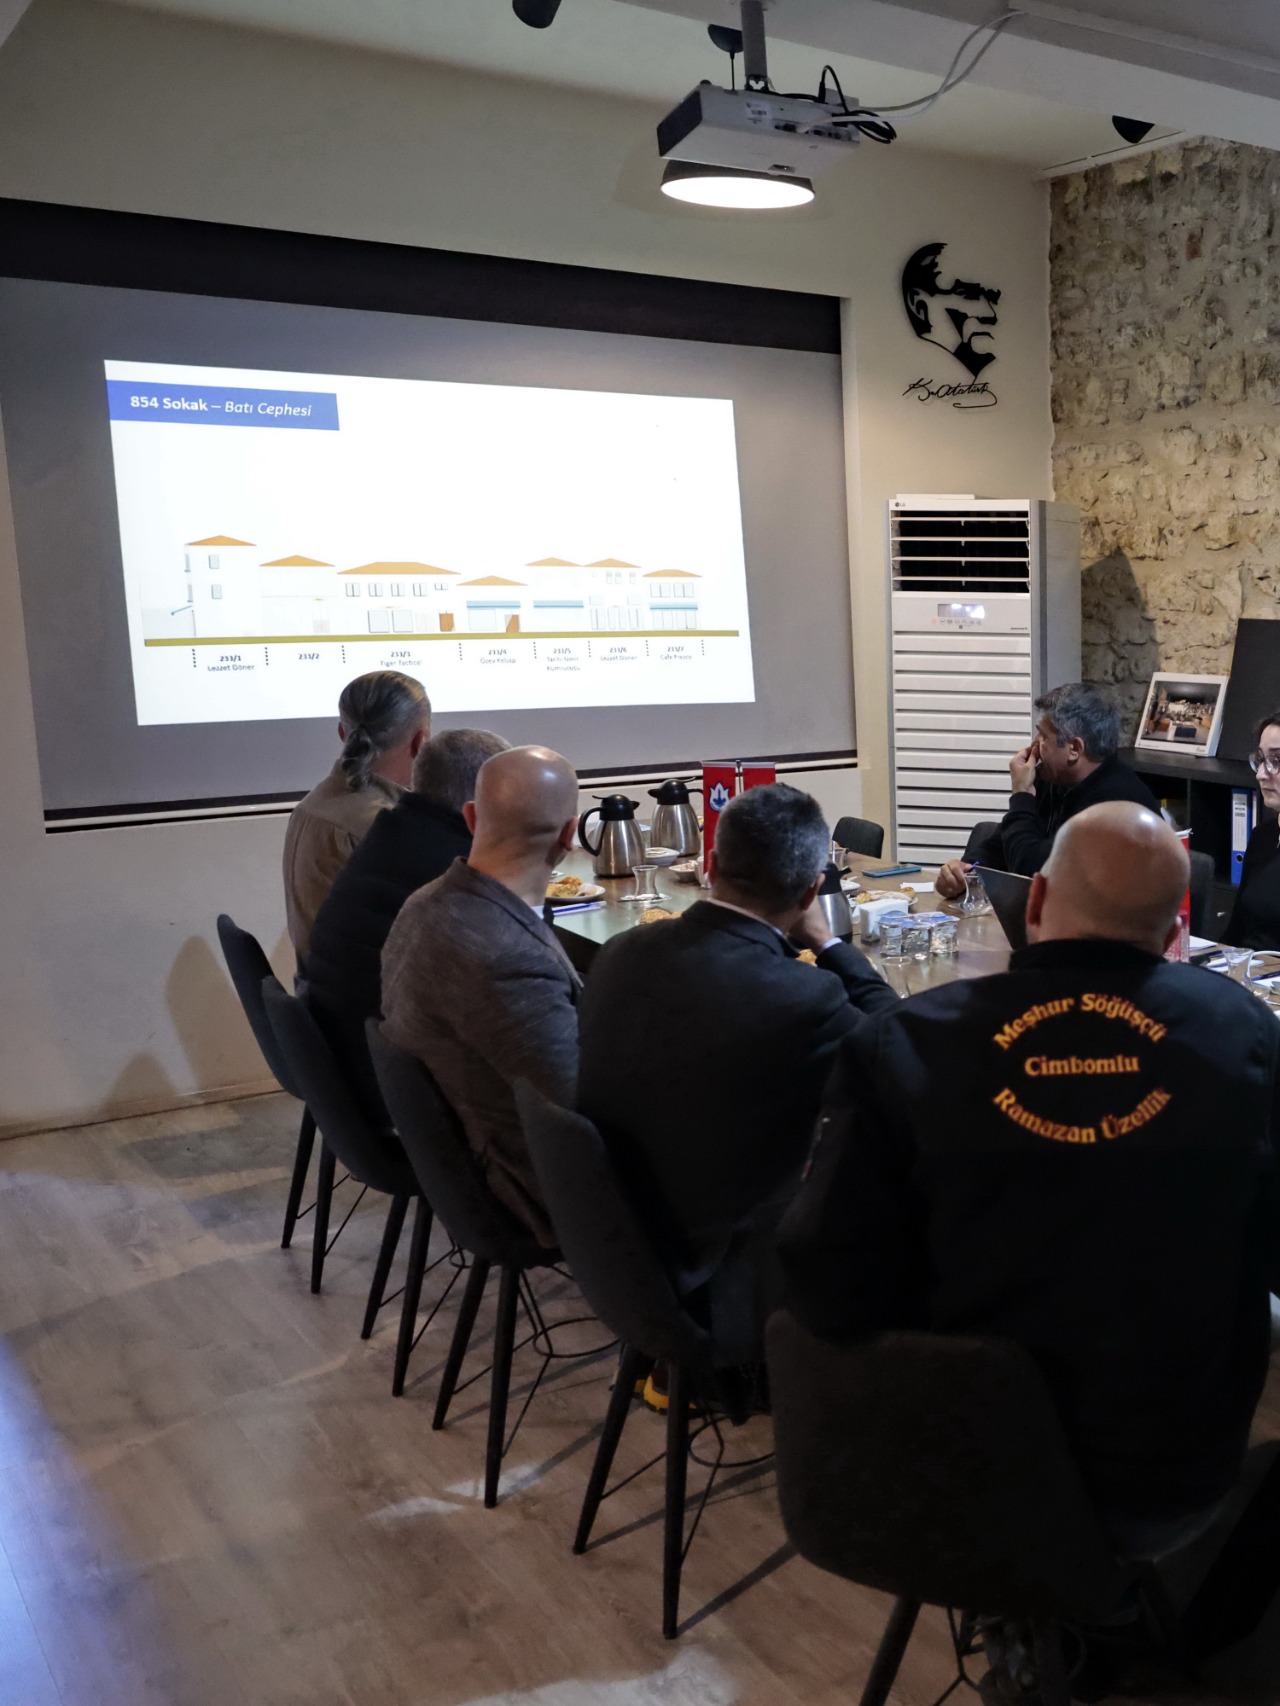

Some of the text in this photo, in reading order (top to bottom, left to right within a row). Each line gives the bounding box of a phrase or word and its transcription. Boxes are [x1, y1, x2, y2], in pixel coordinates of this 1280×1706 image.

[130, 396, 159, 409] 854
[162, 397, 208, 412] Sokak
[225, 401, 254, 414] Batı
[257, 402, 312, 417] Cephesi
[993, 993, 1167, 1050] Meşhur Söğüşçü
[1024, 1054, 1140, 1077] Cimbomlu
[993, 1087, 1098, 1145] Ramazan
